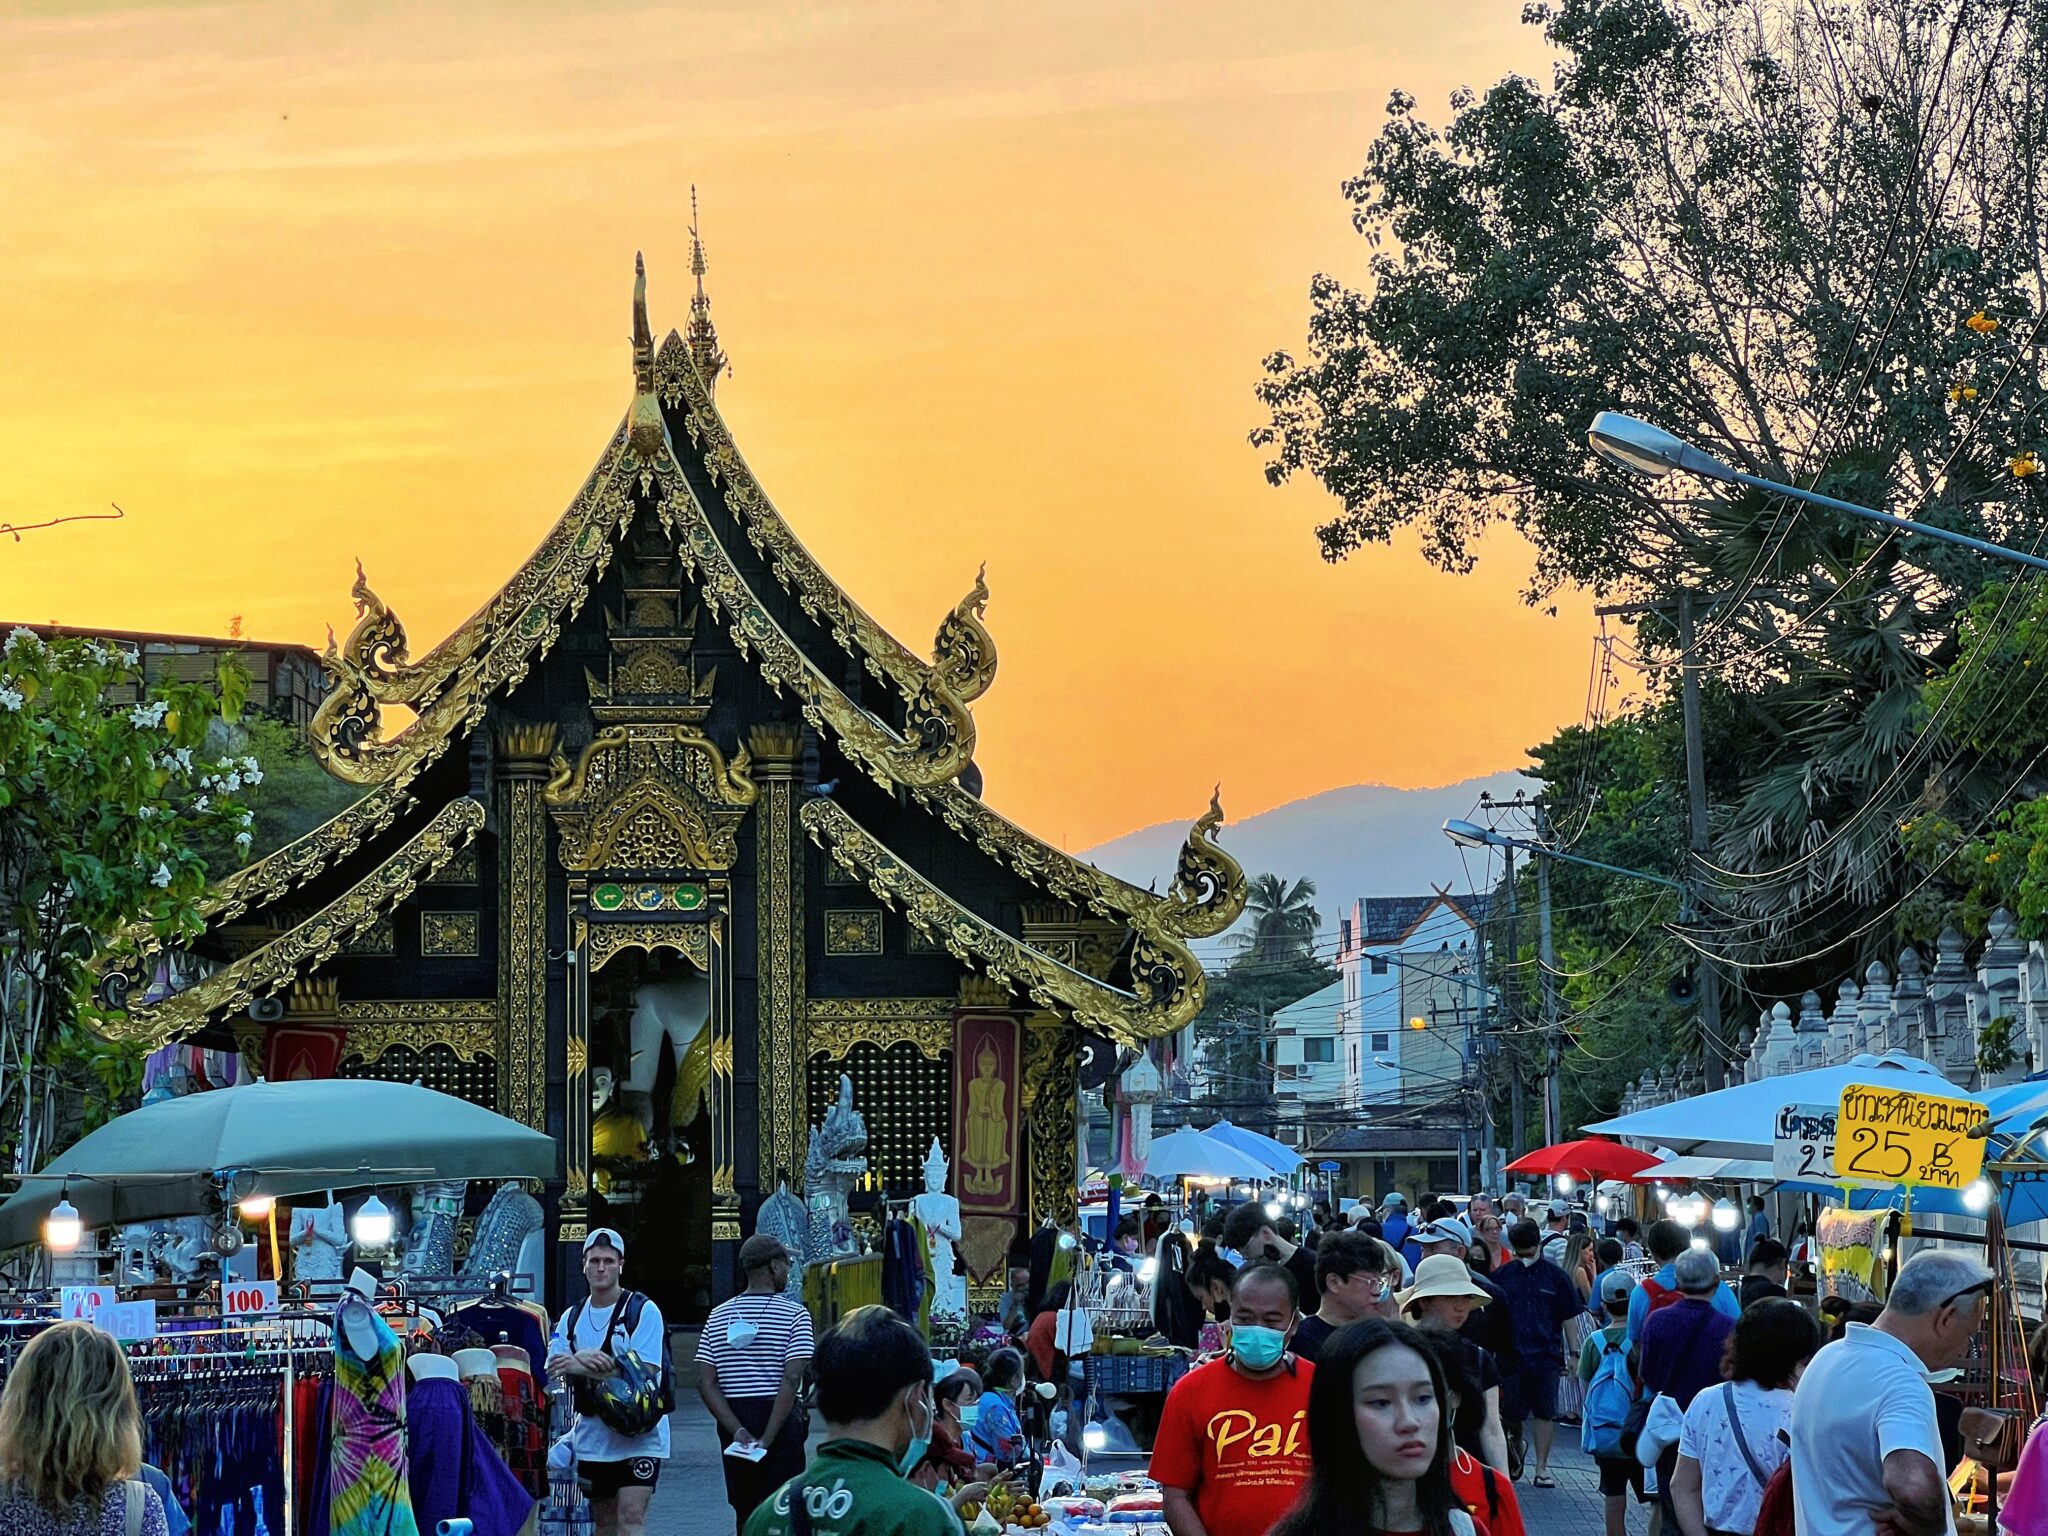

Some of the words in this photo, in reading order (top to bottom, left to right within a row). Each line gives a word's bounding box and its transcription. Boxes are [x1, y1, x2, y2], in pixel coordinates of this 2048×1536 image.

[1797, 1144, 1842, 1179] 25
[1848, 1126, 1912, 1178] 25
[1919, 1165, 1960, 1188] บาท
[226, 1288, 274, 1313] 100.-
[1207, 1409, 1307, 1464] Pai
